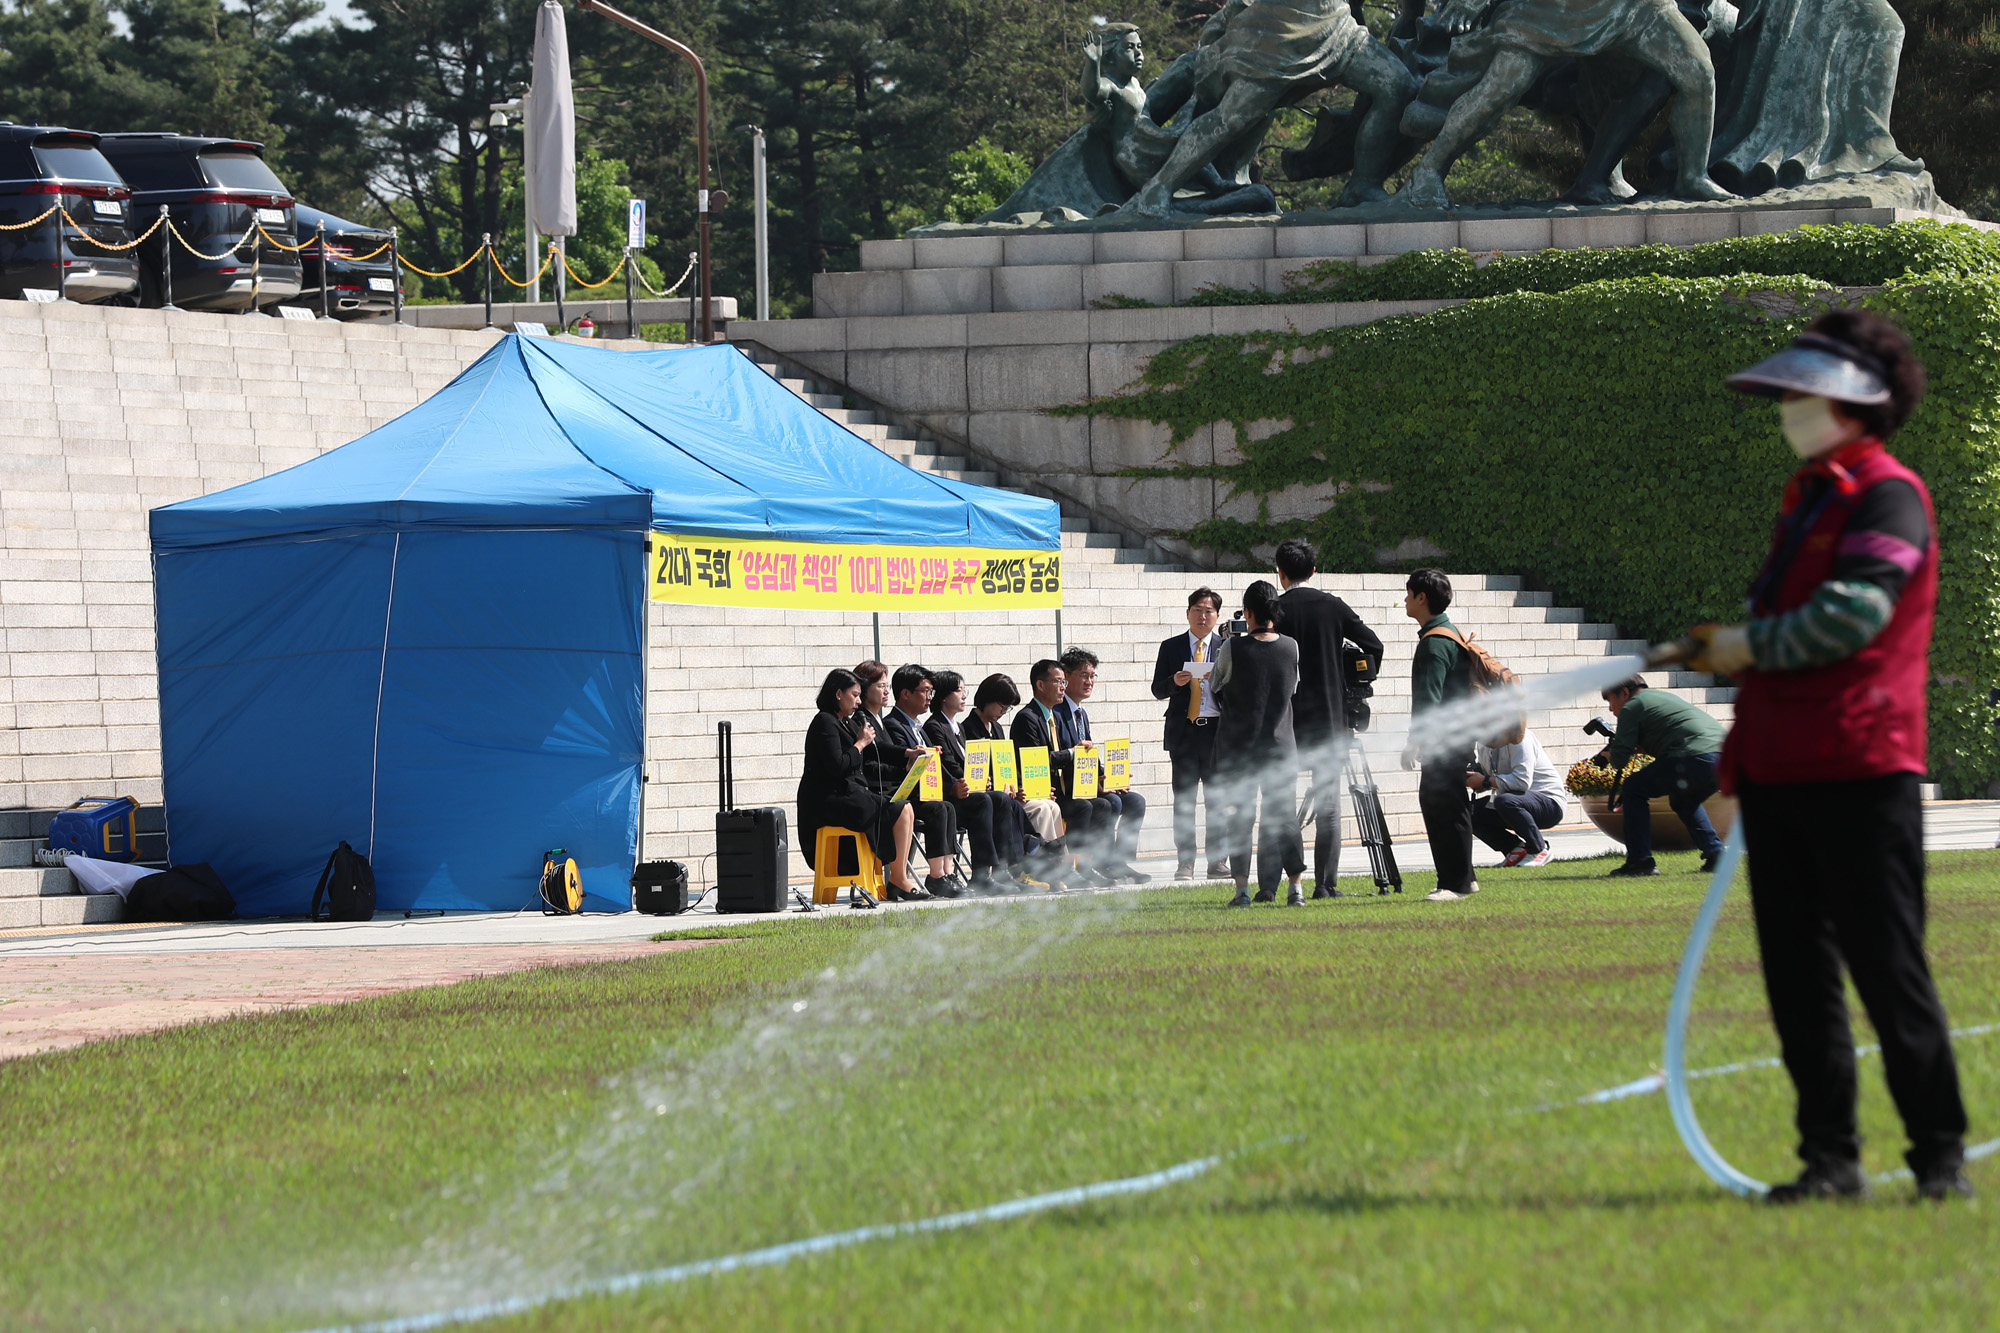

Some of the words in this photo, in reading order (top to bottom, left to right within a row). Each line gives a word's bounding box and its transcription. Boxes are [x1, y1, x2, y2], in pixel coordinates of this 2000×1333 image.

[657, 545, 691, 586] 21대
[694, 548, 732, 589] 국회
[848, 555, 882, 594] 10대
[886, 556, 916, 594] 법안
[919, 557, 948, 594] 입법
[950, 557, 981, 595] 촉구
[981, 558, 1026, 594] 정의당
[1029, 556, 1060, 594] 농성
